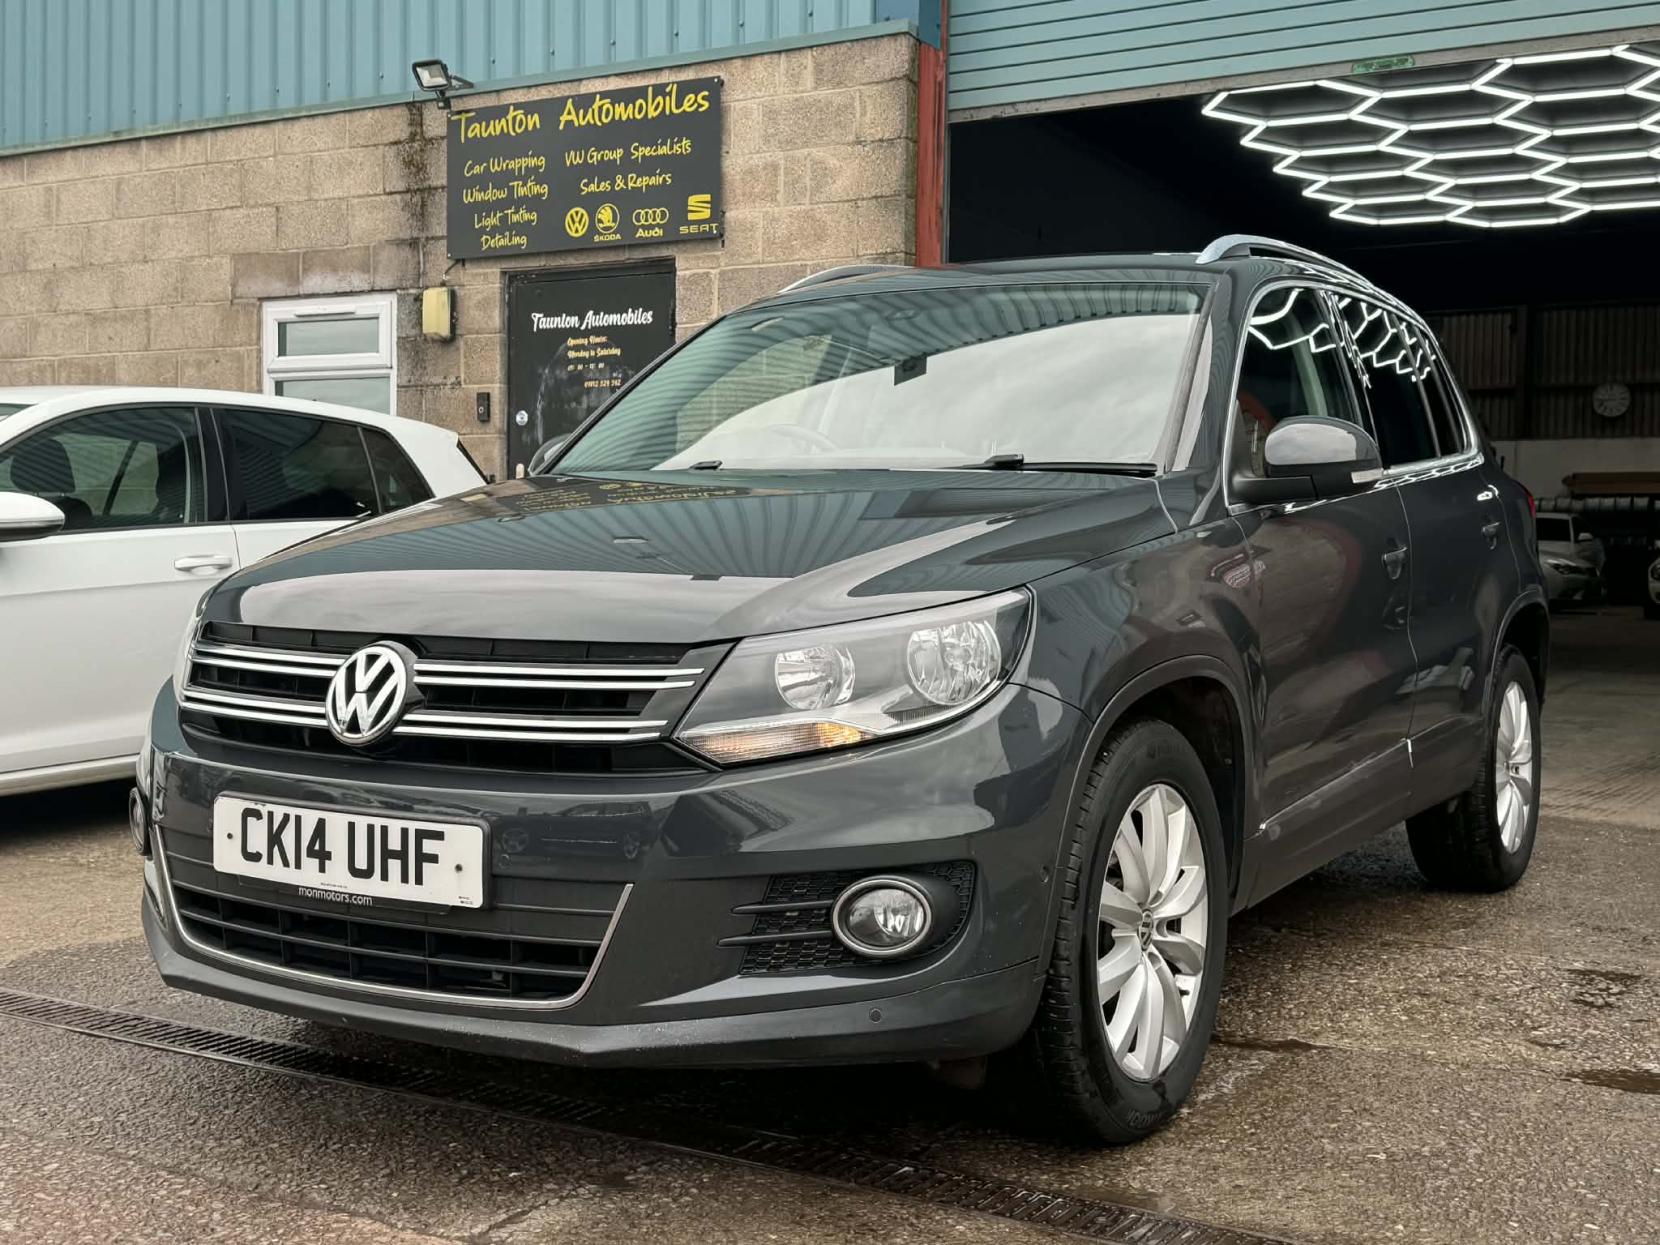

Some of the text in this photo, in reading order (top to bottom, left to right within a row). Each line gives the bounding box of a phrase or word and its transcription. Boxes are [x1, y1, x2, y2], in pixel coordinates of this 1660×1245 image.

[451, 83, 709, 143] Taunton Automobiles
[464, 151, 545, 177] Car Wrapping
[564, 137, 692, 167] VW Group Specialists
[462, 176, 549, 204] Window Tinting
[580, 169, 672, 195] Sales & Repairs
[474, 206, 537, 231] Light Tinting
[679, 223, 719, 234] SEAT
[480, 233, 528, 251] Detailing
[635, 228, 664, 238] Audi
[531, 308, 653, 332] Taunton Automobiles
[241, 807, 445, 886] CK14 UHF
[298, 886, 373, 906] monmotors.com
